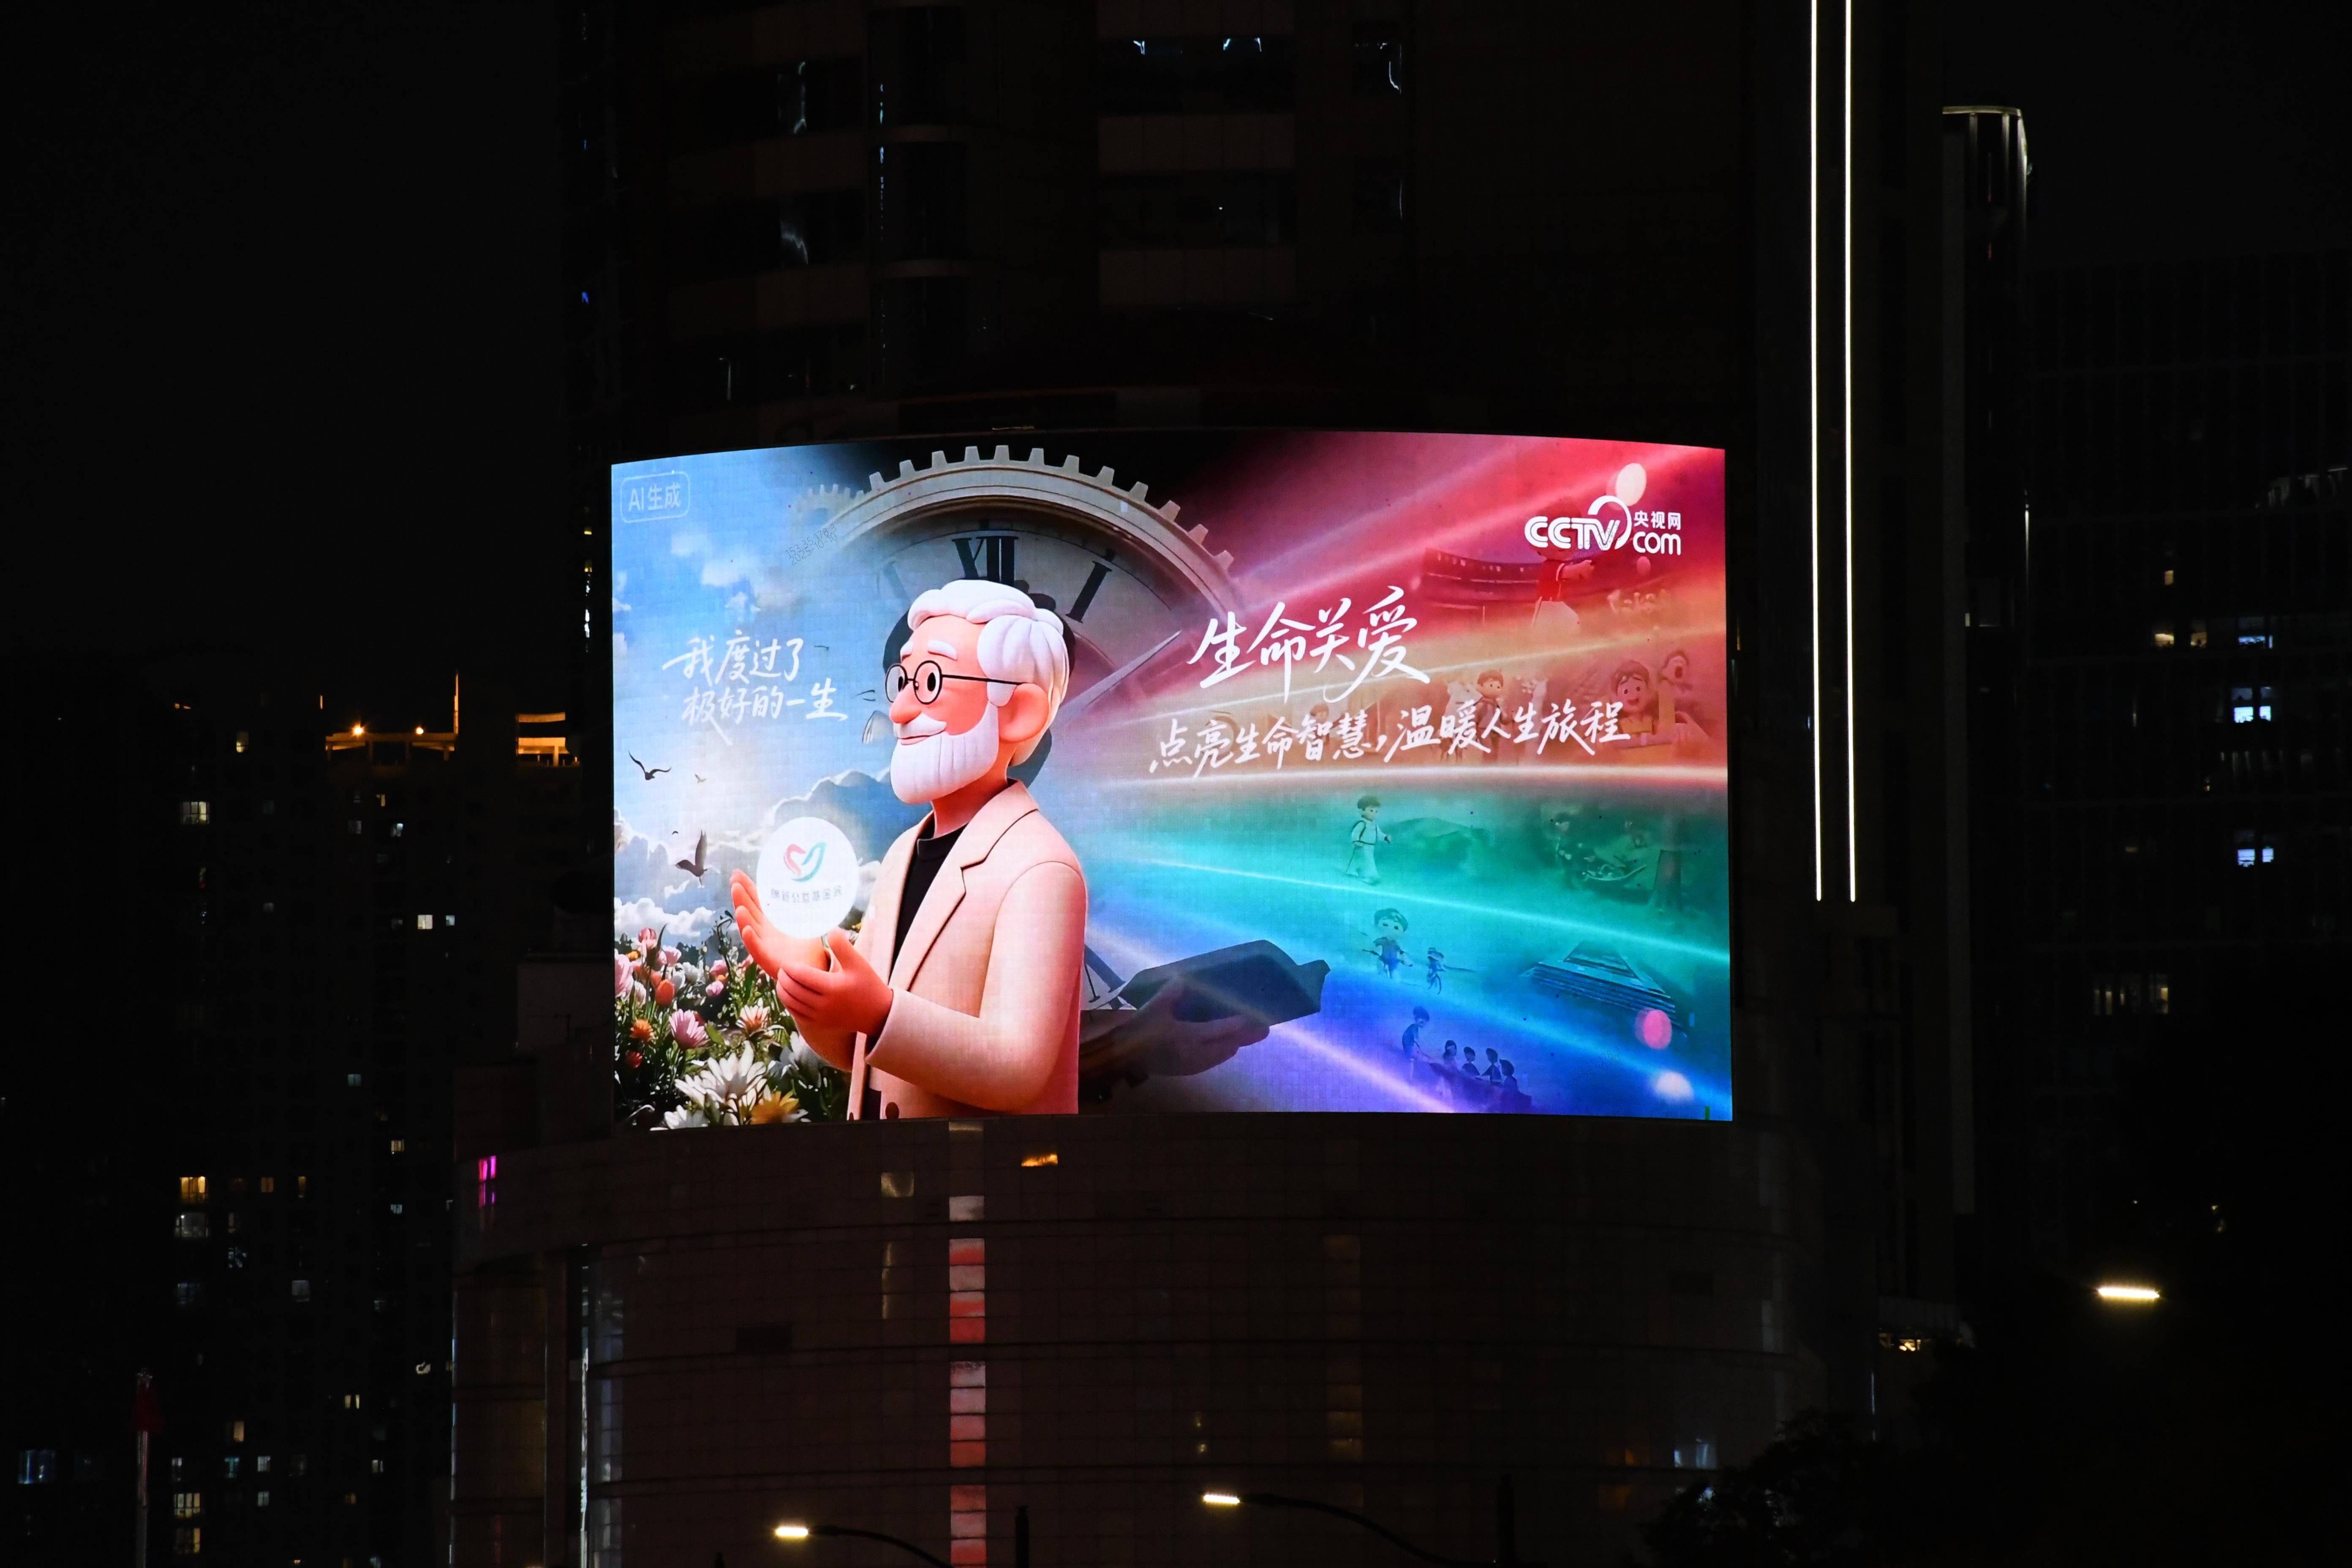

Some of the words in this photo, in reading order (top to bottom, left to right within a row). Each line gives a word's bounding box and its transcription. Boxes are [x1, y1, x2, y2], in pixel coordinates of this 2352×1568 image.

[629, 481, 681, 512] AI生成
[1524, 516, 1620, 551] CCTV
[1633, 510, 1682, 531] 央视网
[662, 630, 803, 686] 我度过了
[1187, 585, 1430, 704] 生命关爱
[681, 678, 848, 746] 极好的一生
